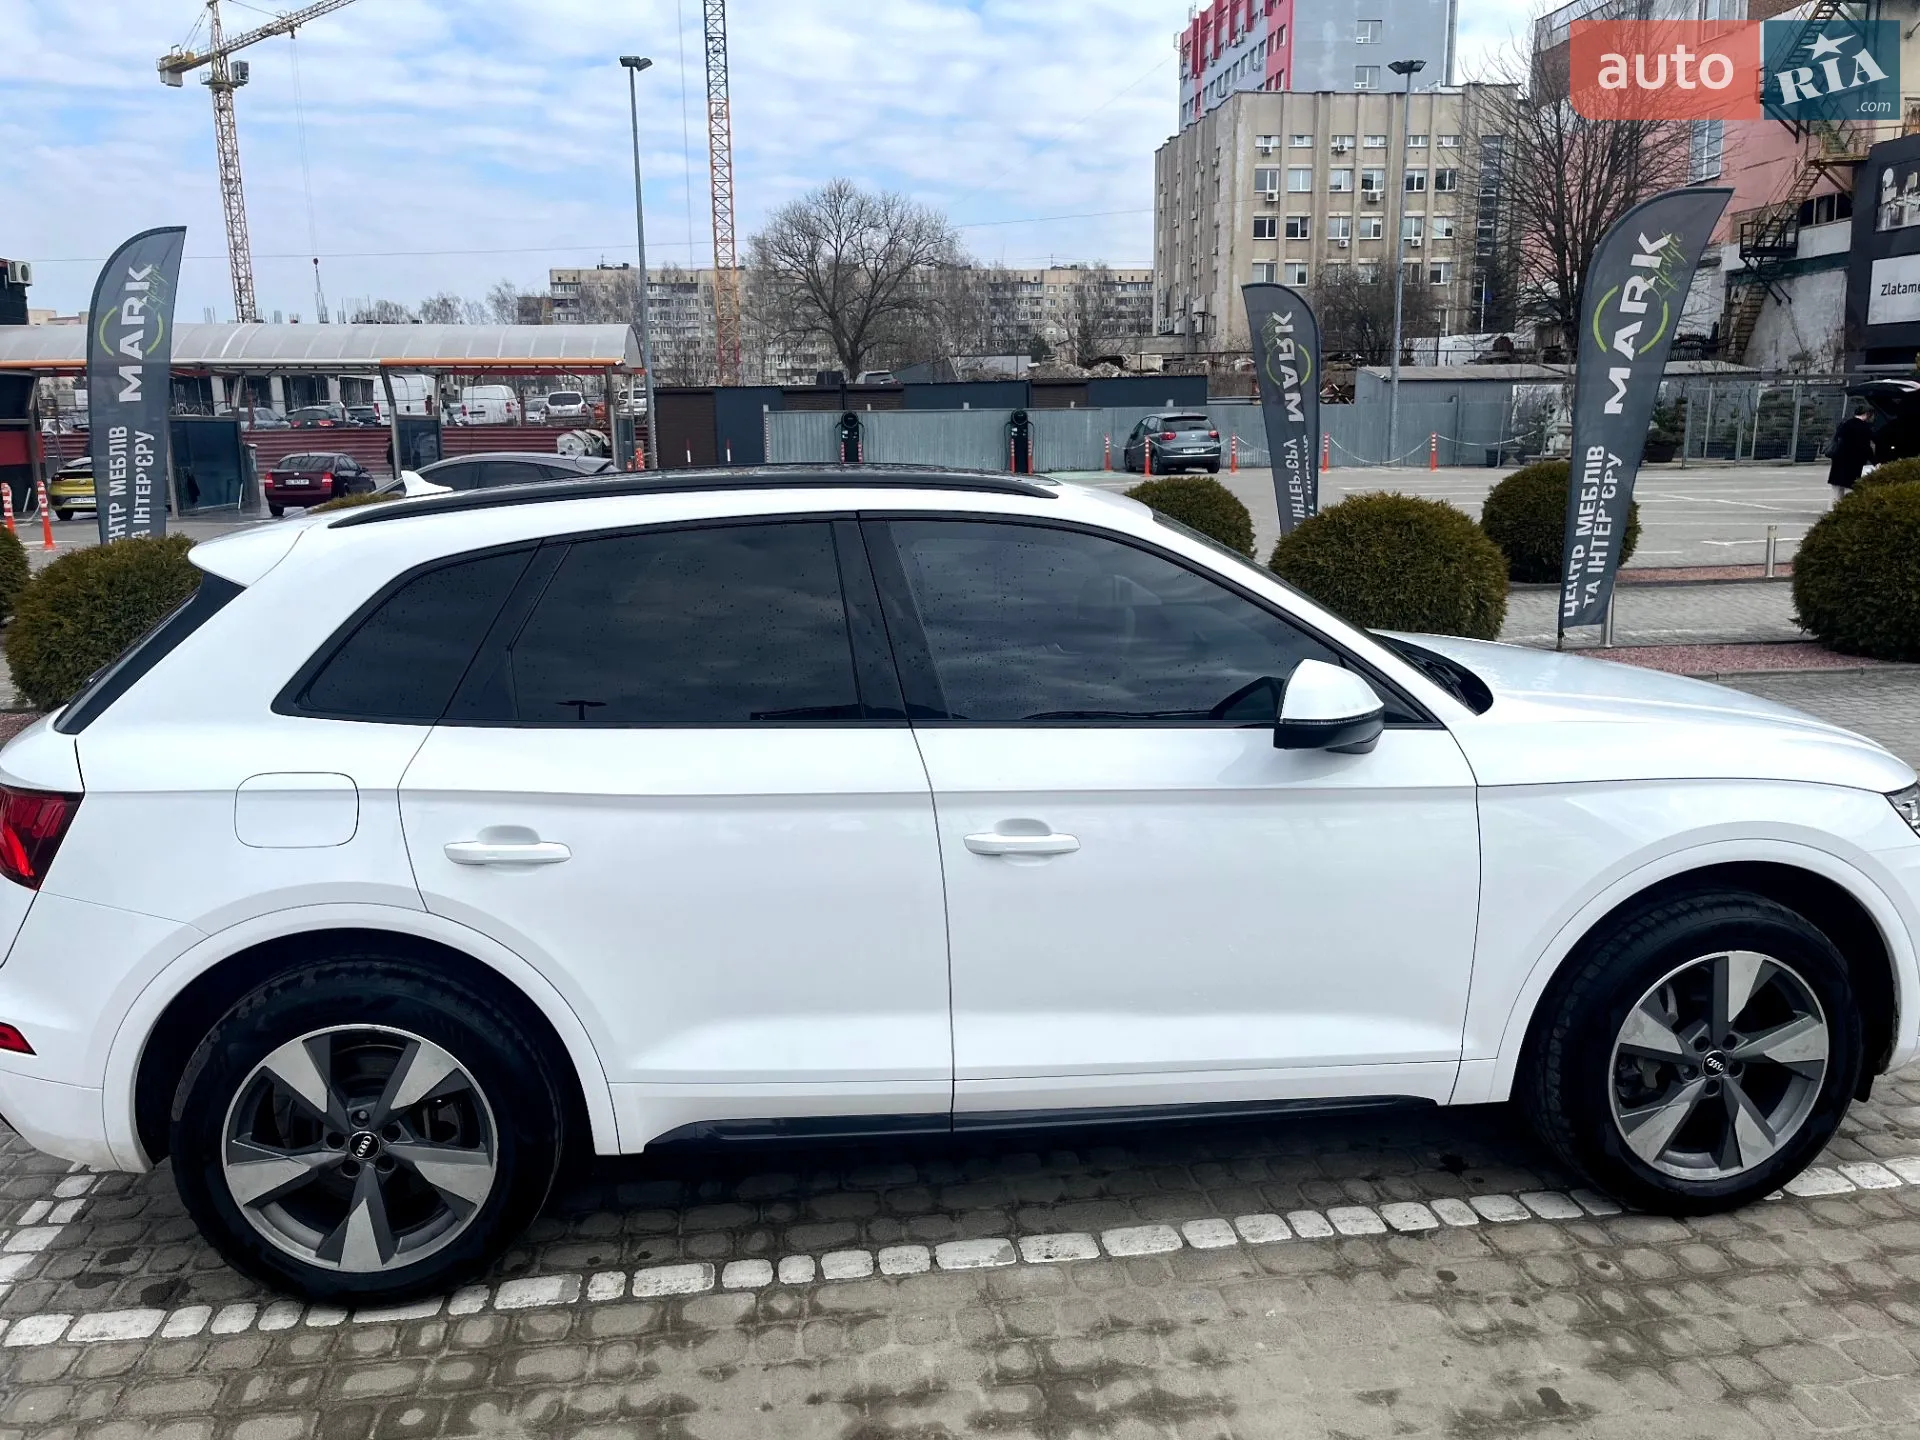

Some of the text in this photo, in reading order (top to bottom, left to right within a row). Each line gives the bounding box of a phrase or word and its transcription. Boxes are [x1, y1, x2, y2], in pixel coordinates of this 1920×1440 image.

[119, 264, 152, 402] MARK
[1604, 232, 1672, 414] MARK
[108, 426, 127, 545] НТР МЕБЛІВ
[1575, 445, 1605, 536] МЕБЛІВ
